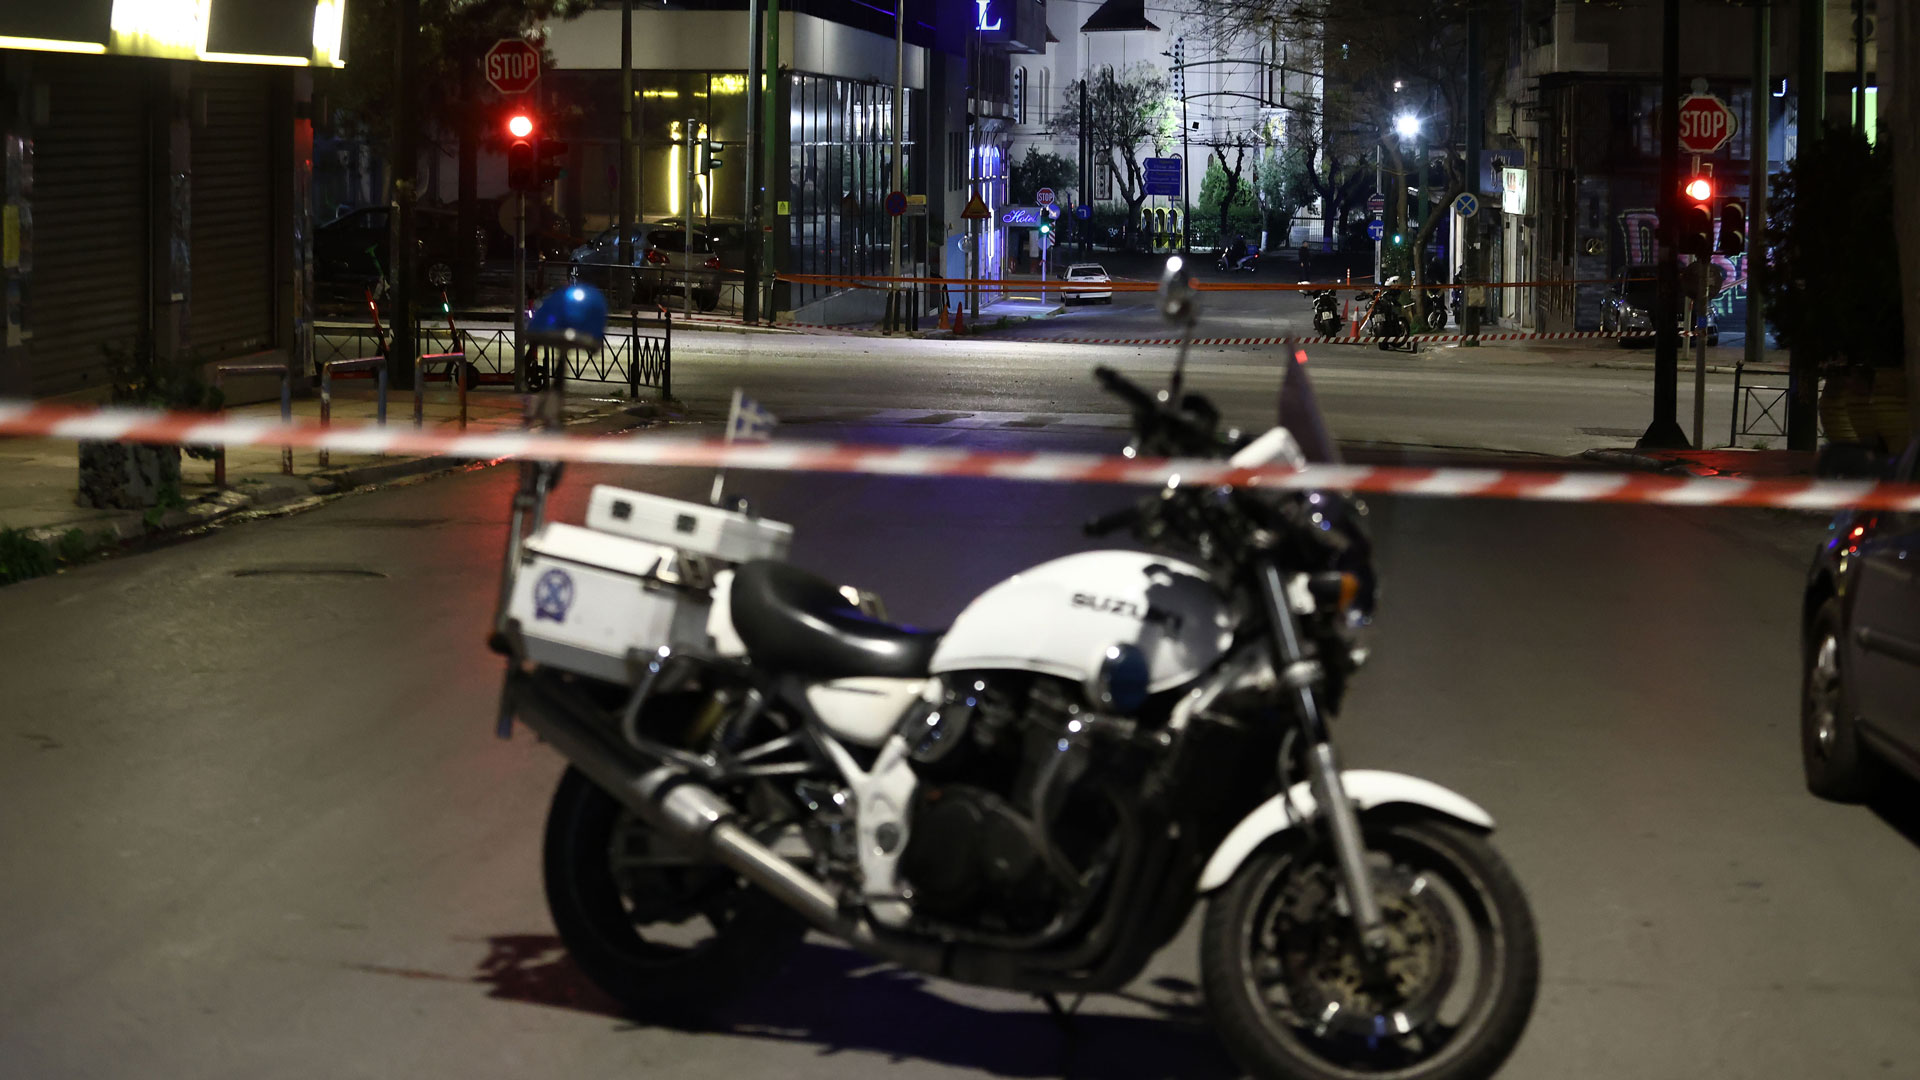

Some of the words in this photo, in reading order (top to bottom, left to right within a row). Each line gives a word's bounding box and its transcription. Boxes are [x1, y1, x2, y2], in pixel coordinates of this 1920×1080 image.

[975, 0, 1002, 31] L
[490, 52, 535, 81] STOP
[1679, 110, 1725, 138] STOP
[1038, 193, 1053, 202] STOP
[1003, 209, 1039, 223] Hotel
